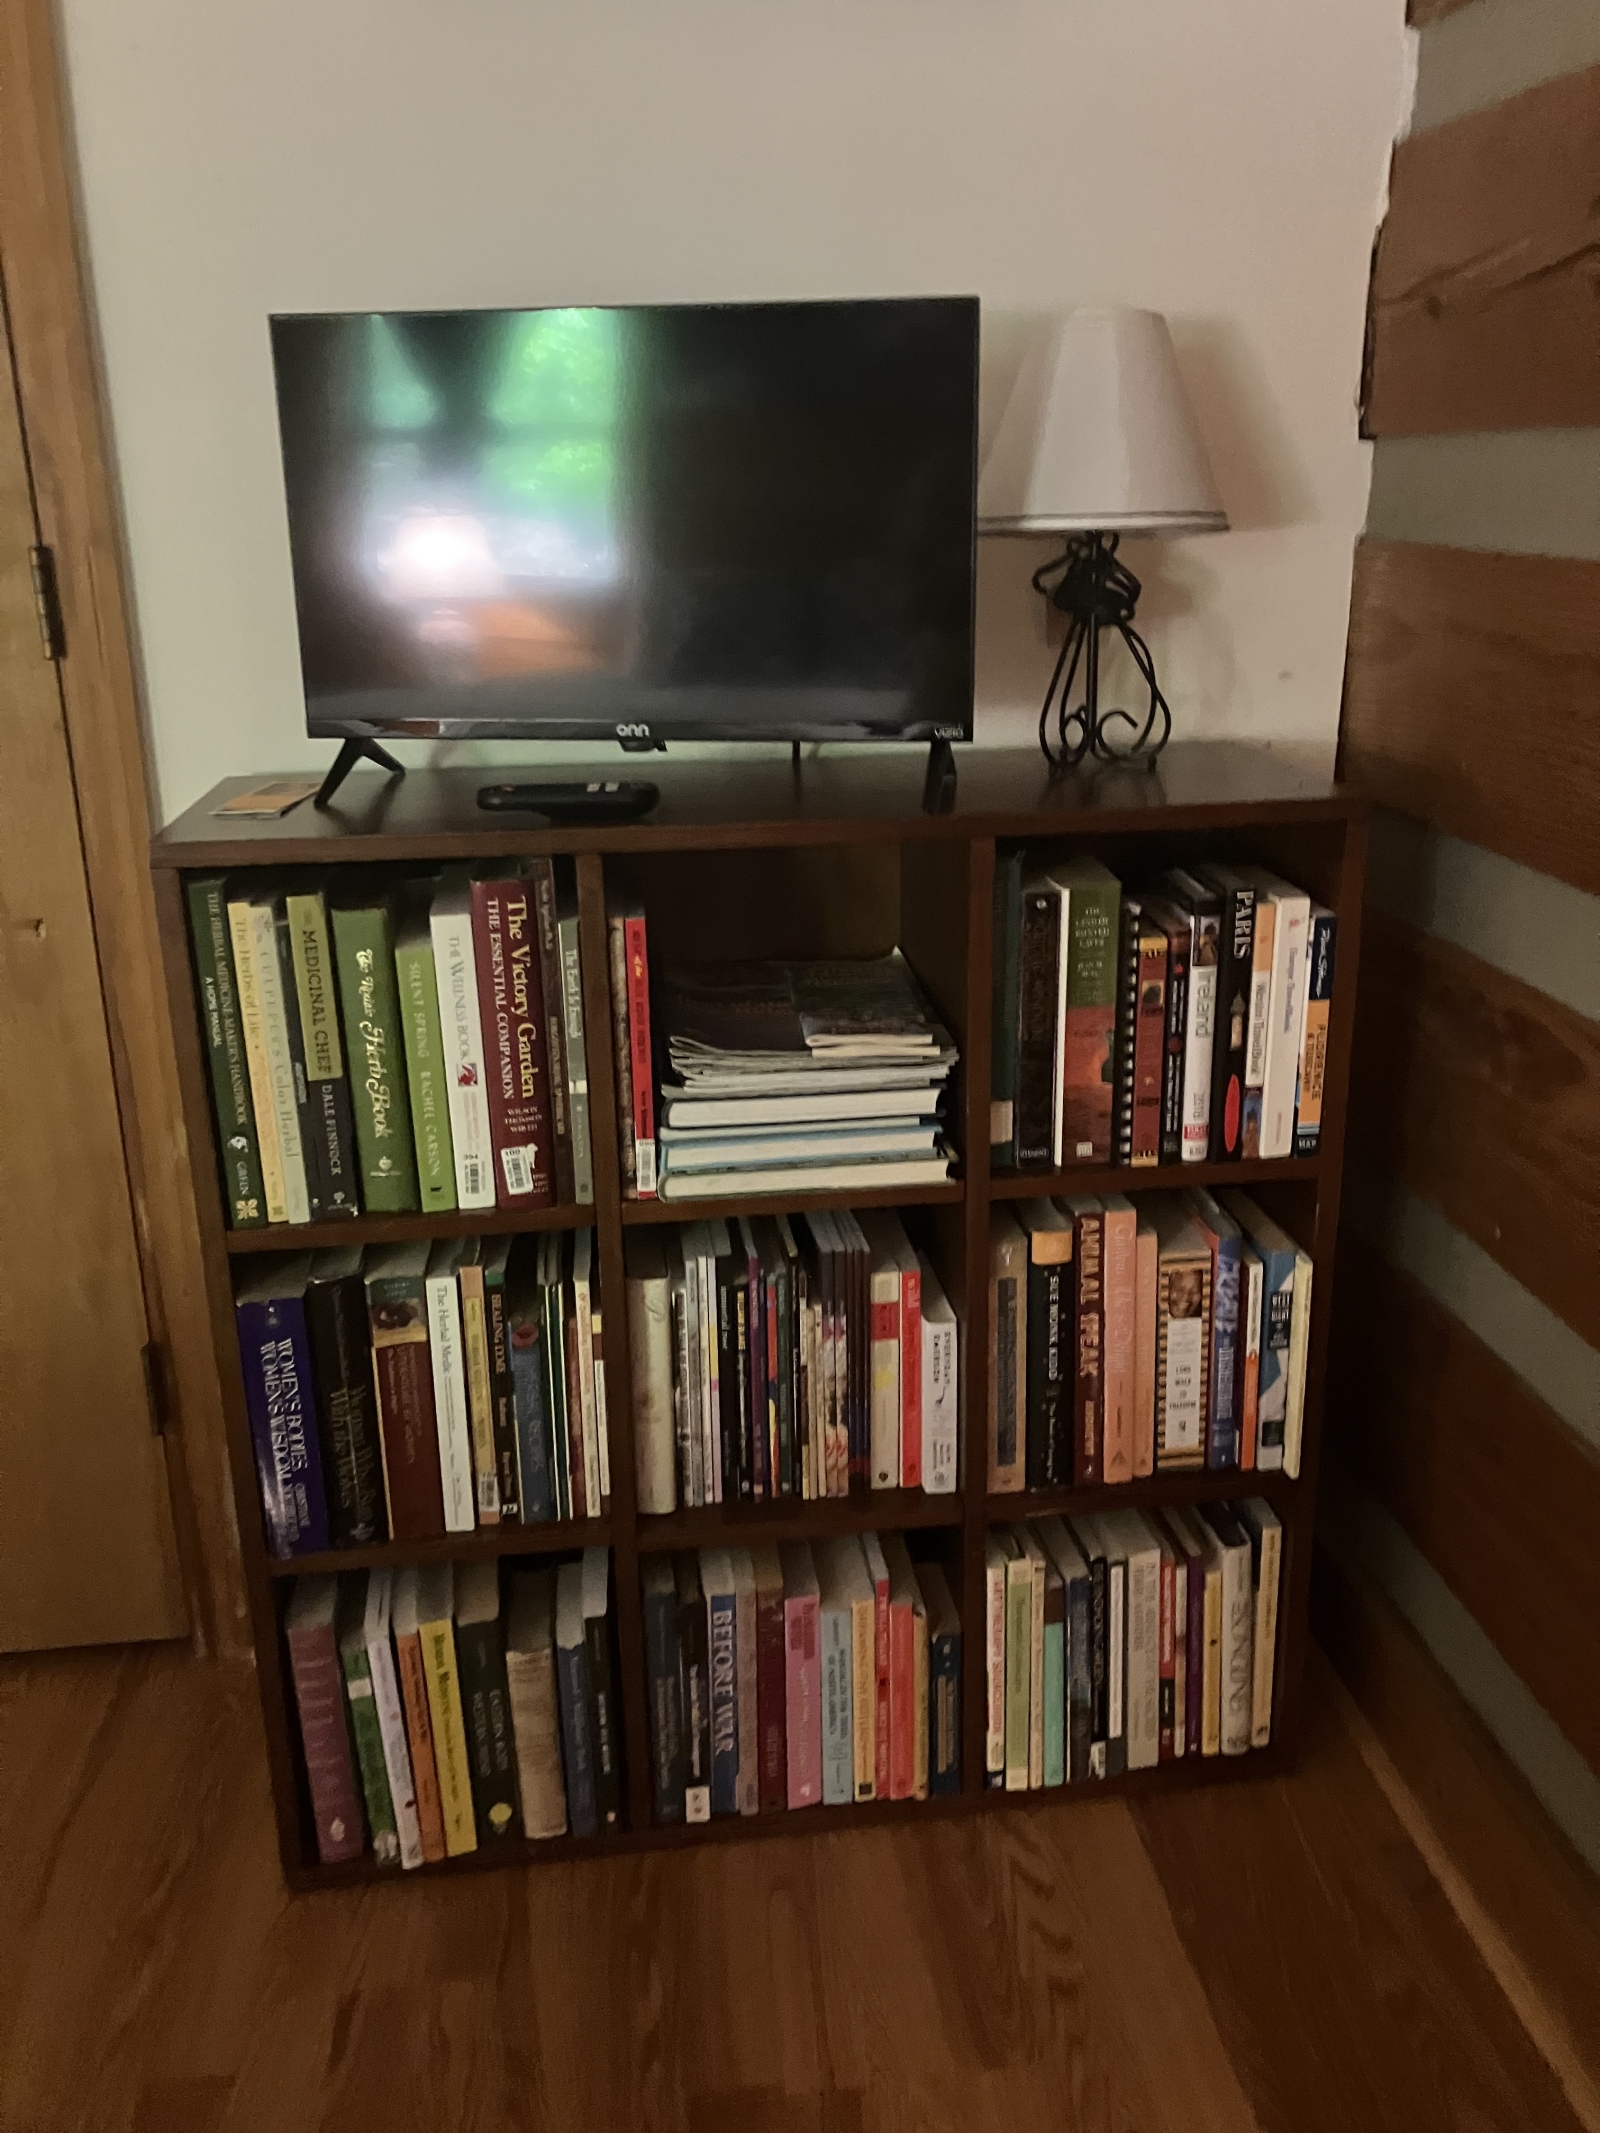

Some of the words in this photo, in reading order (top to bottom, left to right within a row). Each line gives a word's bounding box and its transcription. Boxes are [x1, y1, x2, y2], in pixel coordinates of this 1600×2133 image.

[616, 723, 650, 738] onn
[207, 892, 219, 915] THE
[487, 897, 500, 931] THE
[506, 896, 532, 940] The
[1234, 890, 1256, 961] PARIS
[489, 933, 509, 1010] ESSENTIAL
[509, 944, 533, 1018] Victory
[302, 929, 326, 1026] MEDICINAL
[314, 1030, 331, 1075] CHEF
[358, 1020, 388, 1079] Herb
[496, 1012, 516, 1100] COMPANION
[516, 1023, 541, 1100] Garden
[321, 1084, 335, 1110] DALE
[365, 1078, 394, 1139] Book
[413, 1012, 431, 1058] SPRING
[424, 1124, 442, 1177] CARSON
[325, 1110, 342, 1176] PINNOCK
[1298, 1138, 1318, 1149] MAP
[1049, 1275, 1060, 1303] SUE
[1080, 1217, 1101, 1306] ANIMAL
[436, 1285, 448, 1306] The
[437, 1308, 451, 1342] Herbal
[1271, 1294, 1291, 1306] WEST
[269, 1414, 293, 1480] WISDOM
[286, 1414, 309, 1473] BODIES
[711, 1608, 736, 1698] BEFORE
[712, 1701, 736, 1757] WAR
